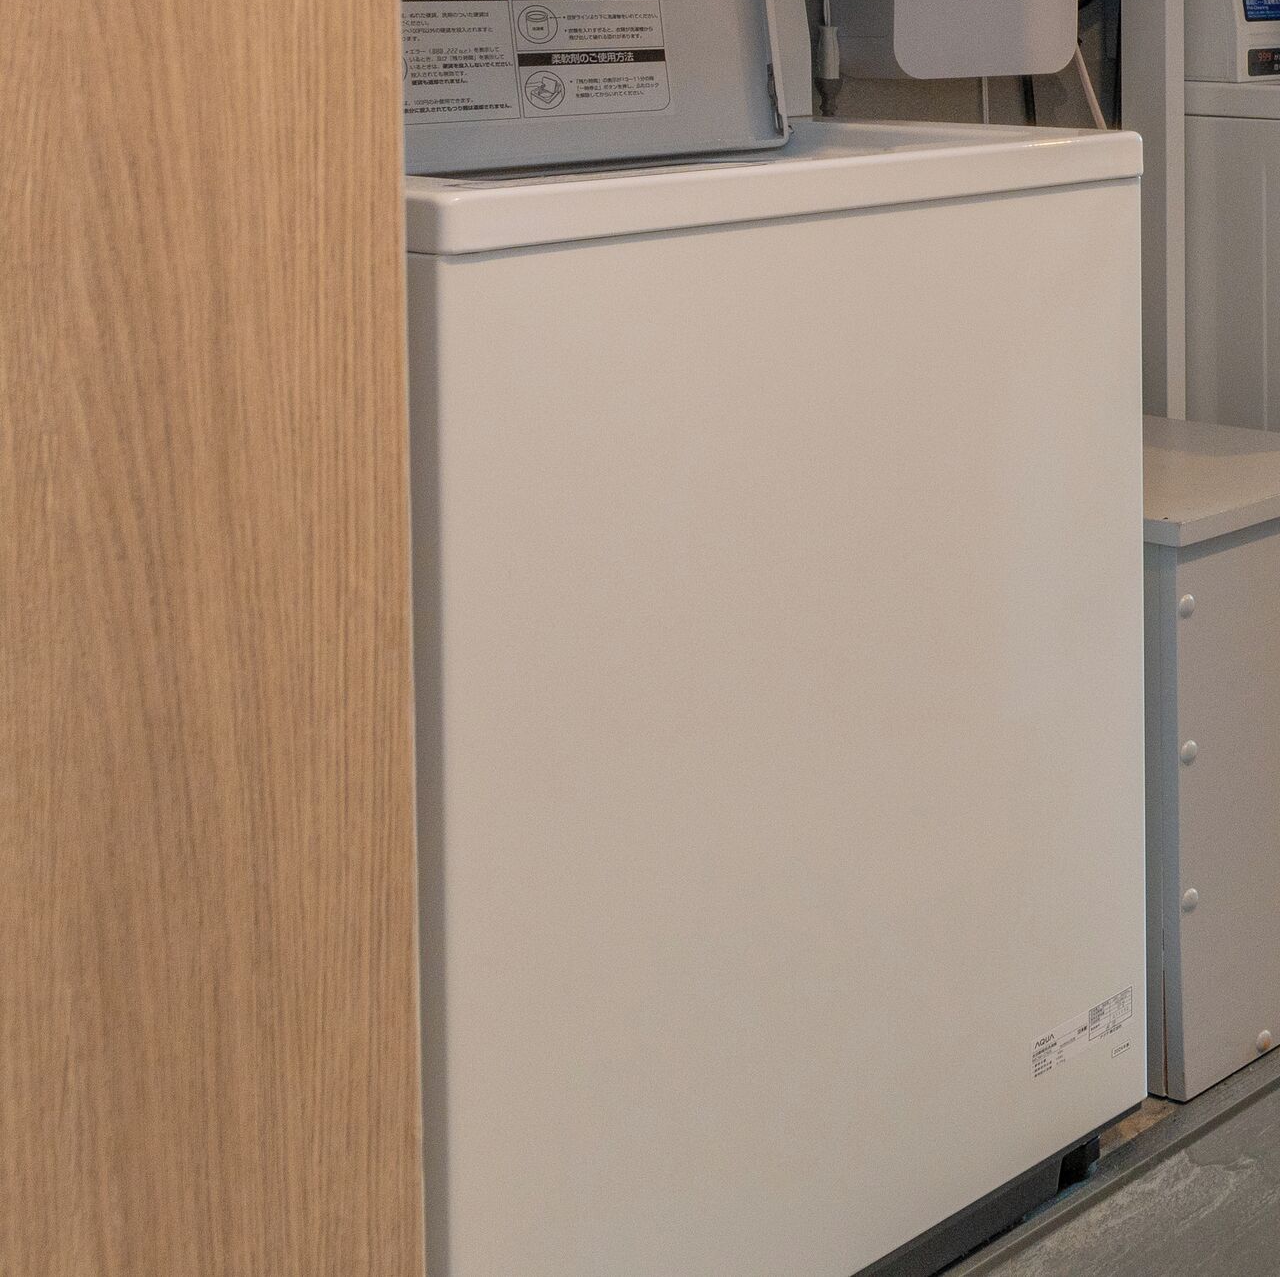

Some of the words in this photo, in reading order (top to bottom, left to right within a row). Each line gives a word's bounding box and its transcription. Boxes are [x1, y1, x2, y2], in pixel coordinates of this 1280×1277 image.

[551, 52, 635, 65] 柔軟剤のご使用方法
[1035, 1033, 1055, 1049] AQUA
